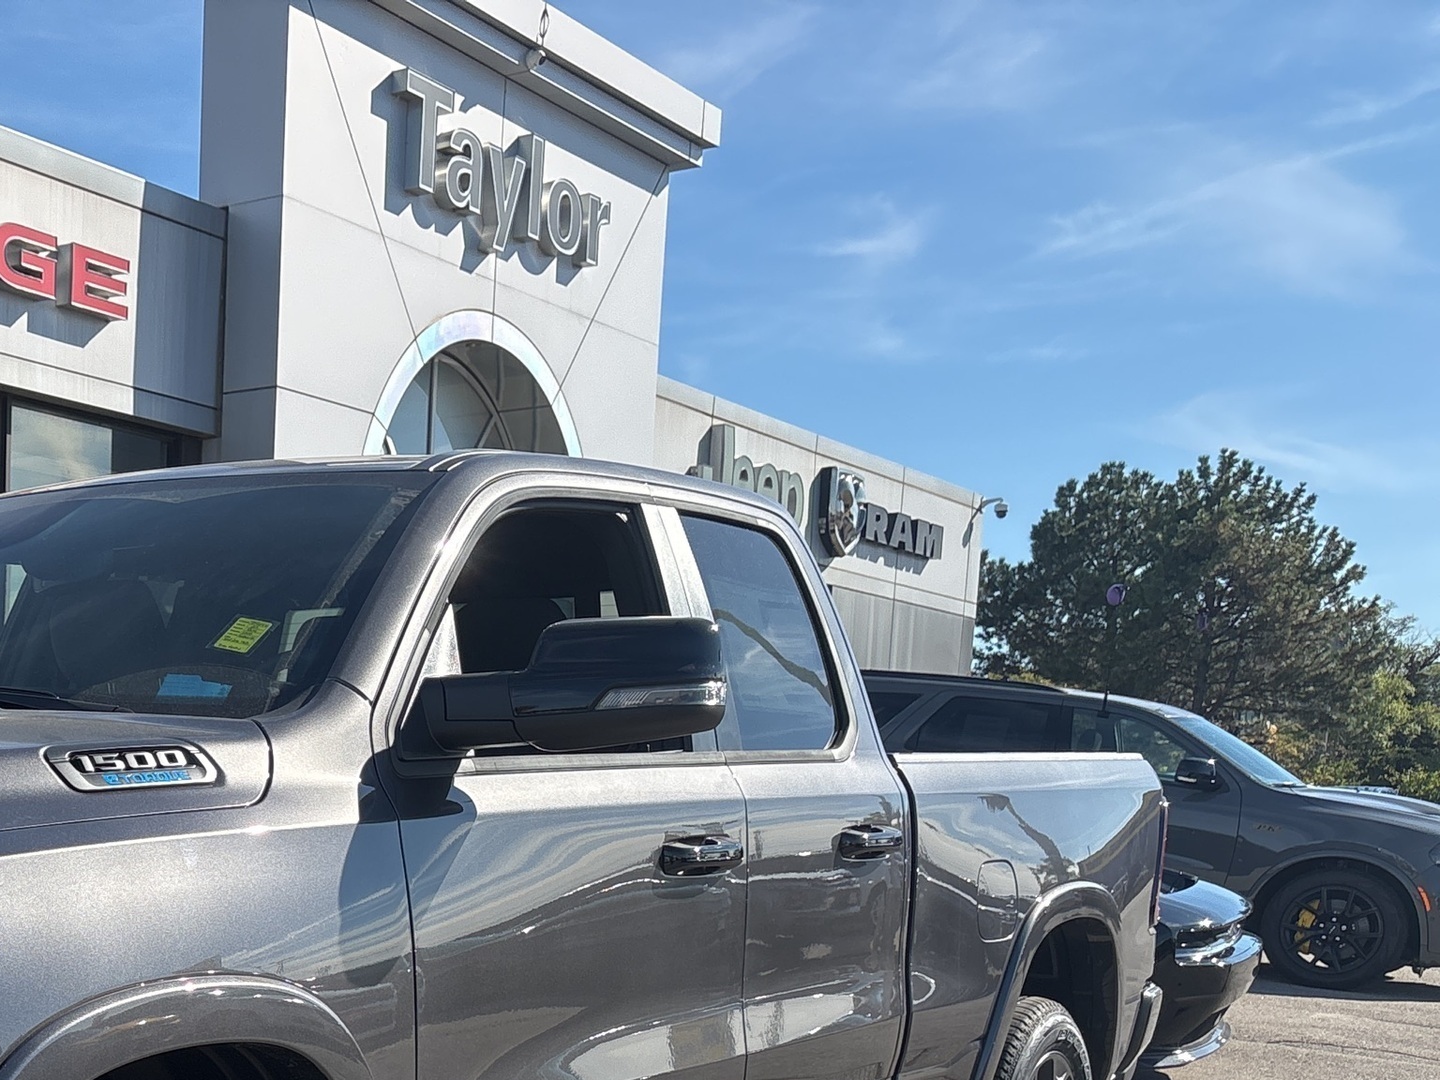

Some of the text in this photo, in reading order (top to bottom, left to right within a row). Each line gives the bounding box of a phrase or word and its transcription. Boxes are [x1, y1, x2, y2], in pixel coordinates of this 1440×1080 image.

[393, 66, 610, 267] Taylor
[863, 503, 944, 560] RAM
[74, 750, 188, 773] 1500
